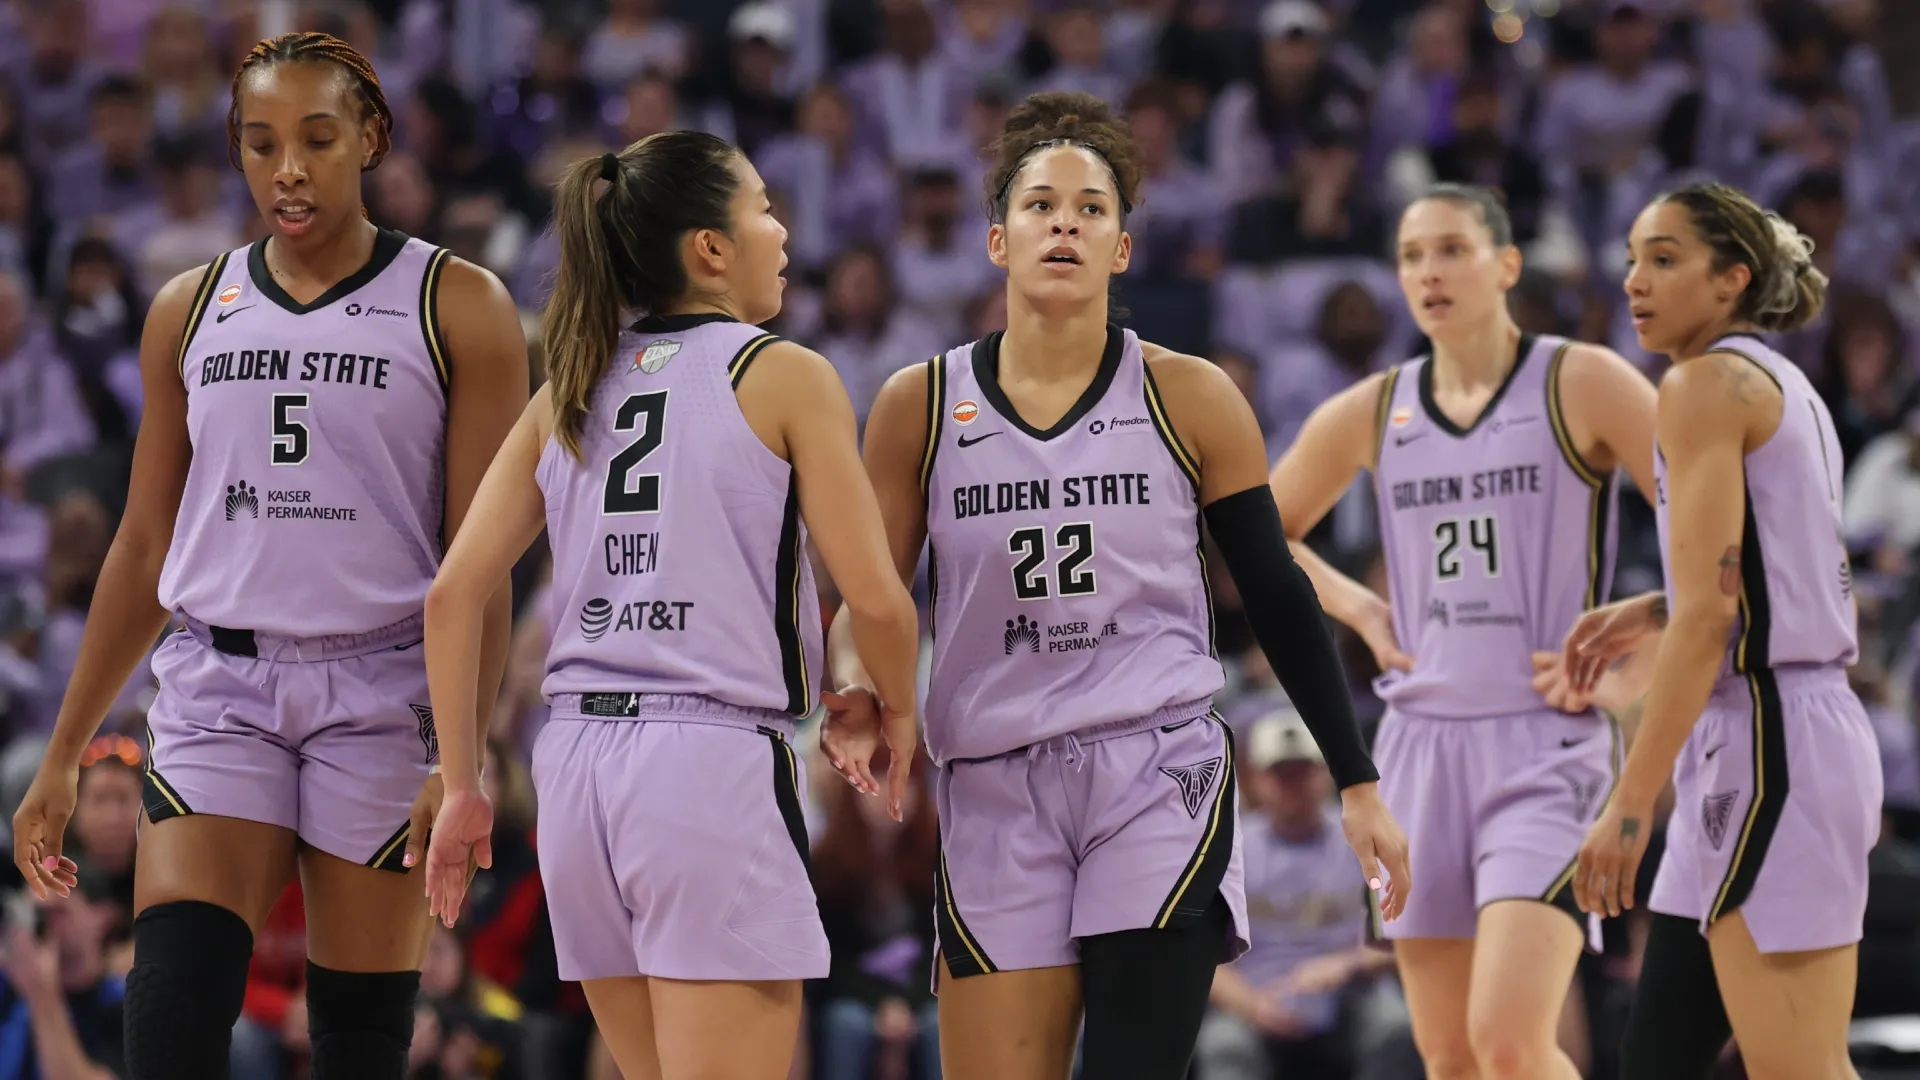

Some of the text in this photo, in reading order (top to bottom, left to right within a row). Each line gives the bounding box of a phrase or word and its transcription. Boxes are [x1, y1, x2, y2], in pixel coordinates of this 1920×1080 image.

[365, 305, 409, 320] freedom
[201, 350, 390, 390] GOLDEN STATE
[270, 393, 310, 466] 5
[1109, 416, 1150, 431] freedom
[602, 387, 671, 517] 2
[267, 490, 311, 503] KAISER
[953, 473, 1150, 520] GOLDEN STATE
[1393, 463, 1541, 511] GOLDEN STATE
[267, 506, 357, 521] PERMANENTE
[605, 531, 660, 576] CHEN
[1007, 521, 1098, 601] 22
[1434, 512, 1501, 582] 24
[614, 601, 695, 633] AT&T
[1047, 621, 1090, 638] KAISER
